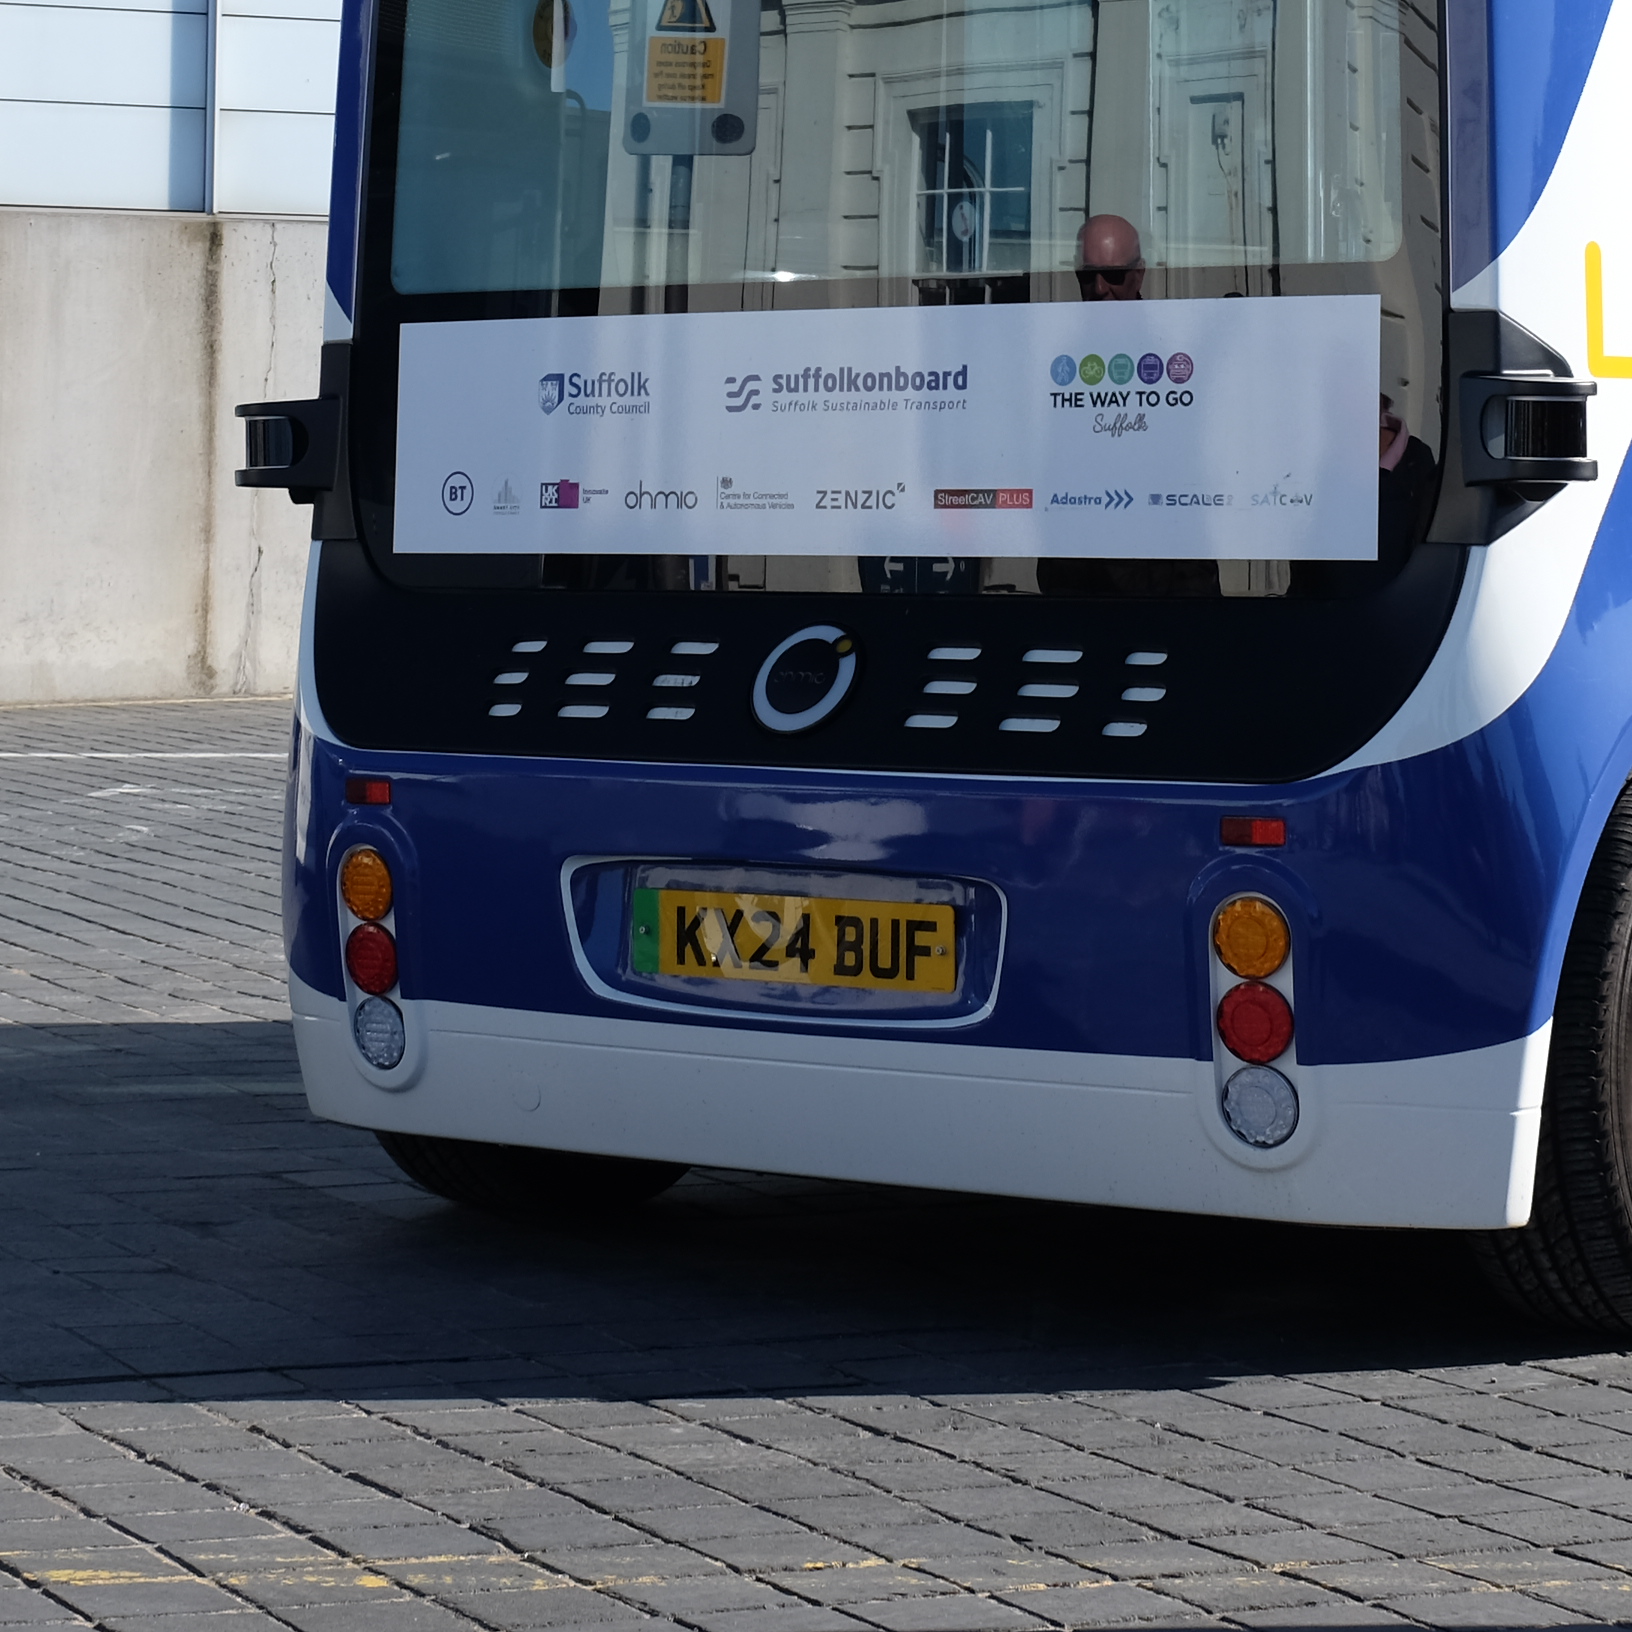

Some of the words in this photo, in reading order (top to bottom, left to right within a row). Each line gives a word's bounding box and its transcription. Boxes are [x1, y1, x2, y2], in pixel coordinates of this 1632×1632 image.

[568, 371, 650, 398] Suffolk
[771, 364, 968, 394] suffolkonboard
[771, 400, 818, 413] Suffolk
[822, 399, 898, 412] Sustainable
[903, 398, 968, 412] Transport
[1049, 392, 1085, 408] THE
[1089, 391, 1131, 408] WAY
[1135, 390, 1161, 407] TO
[1165, 390, 1194, 407] GO
[568, 402, 606, 417] County
[610, 401, 650, 415] Council
[1092, 413, 1149, 437] Suffolk
[449, 485, 467, 502] BT
[624, 480, 698, 509] ohmio
[719, 491, 742, 500] Centre
[742, 491, 752, 500] for
[753, 491, 789, 500] Connected
[815, 489, 897, 510] ZENZIC
[937, 492, 994, 506] StreetCAV
[999, 492, 1031, 506] PLUS
[1050, 491, 1103, 506] Adastra
[726, 501, 766, 509] Autonomous
[767, 501, 795, 509] Vehicles
[676, 905, 816, 973] KX24
[833, 914, 938, 981] BUF
